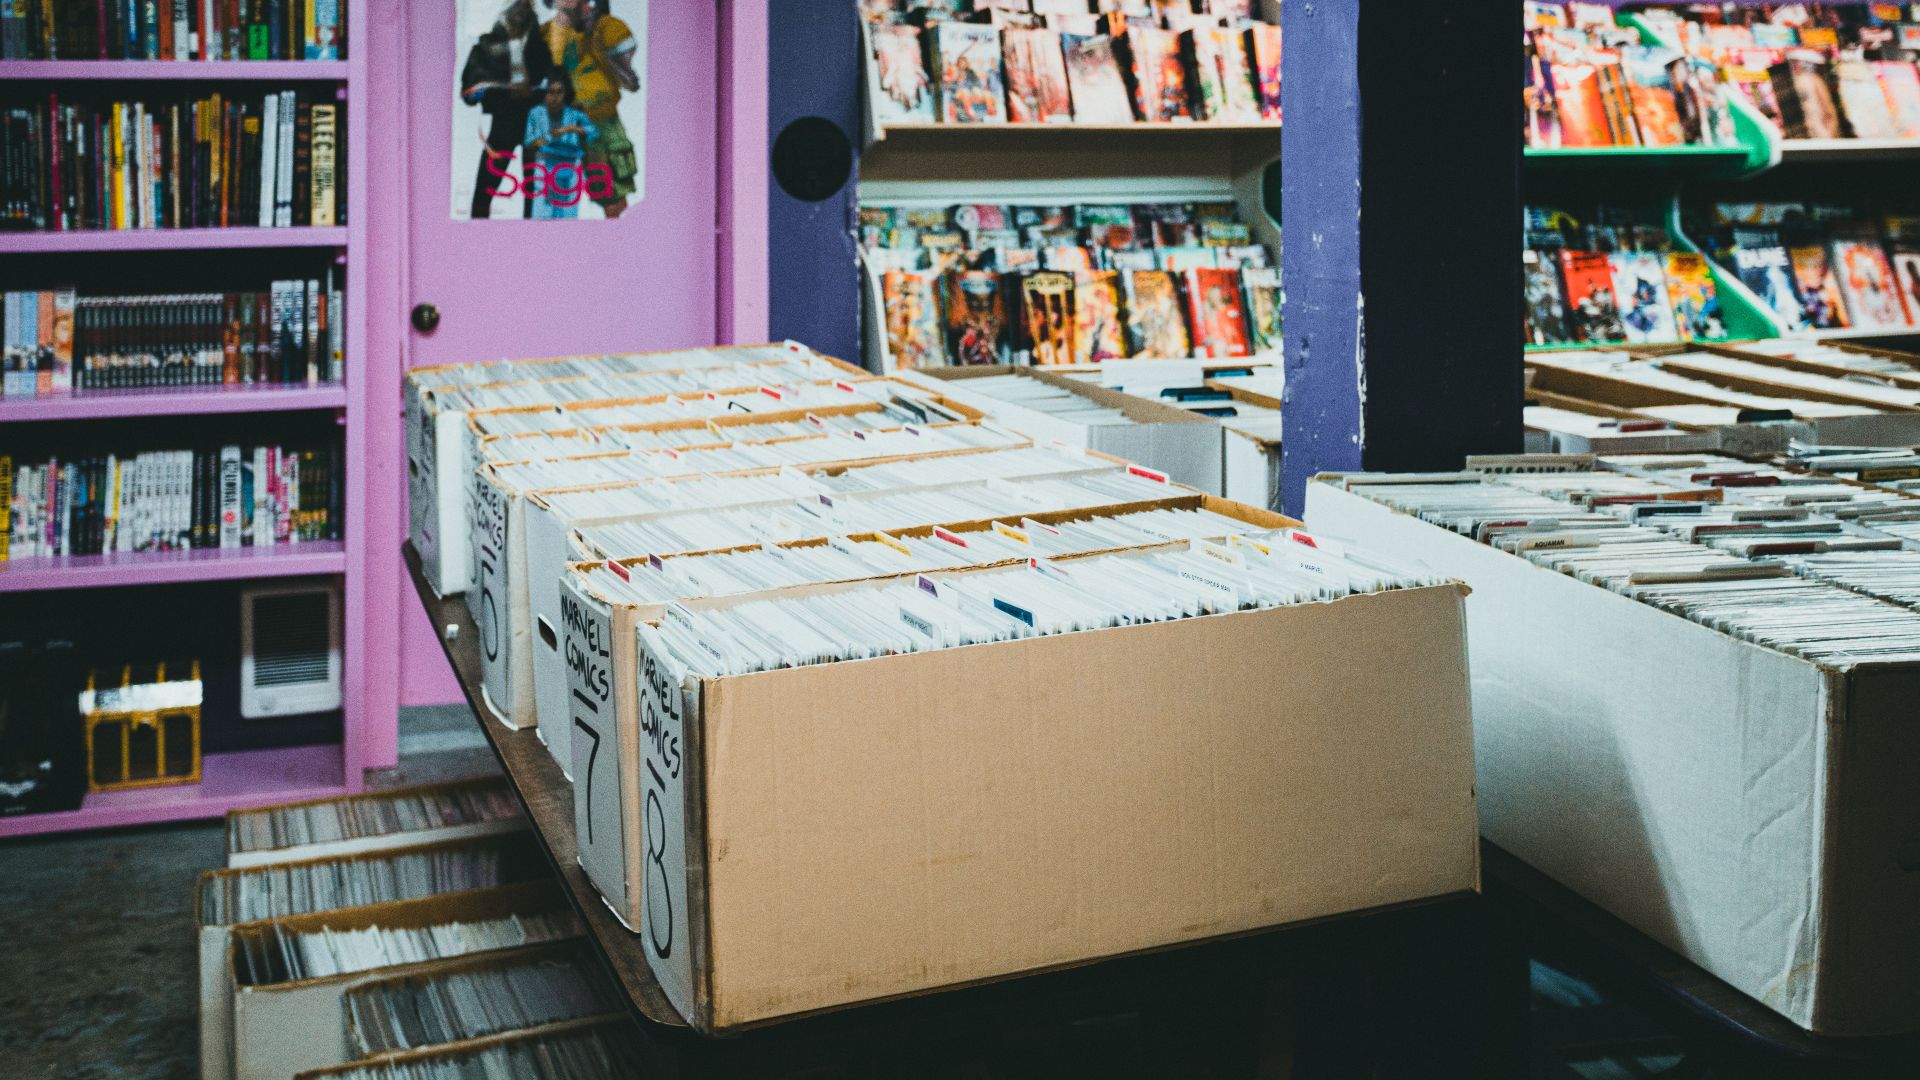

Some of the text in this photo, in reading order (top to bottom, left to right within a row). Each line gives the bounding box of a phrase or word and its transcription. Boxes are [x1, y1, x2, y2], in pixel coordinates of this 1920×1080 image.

[485, 150, 614, 207] Saga
[1534, 539, 1564, 547] AQUAMAN
[561, 594, 609, 657] MARVEL
[565, 634, 609, 702] COMICS
[640, 648, 679, 721] MARVEL
[640, 688, 681, 778] COMICS
[575, 716, 600, 844] 7
[646, 788, 673, 959] 8
